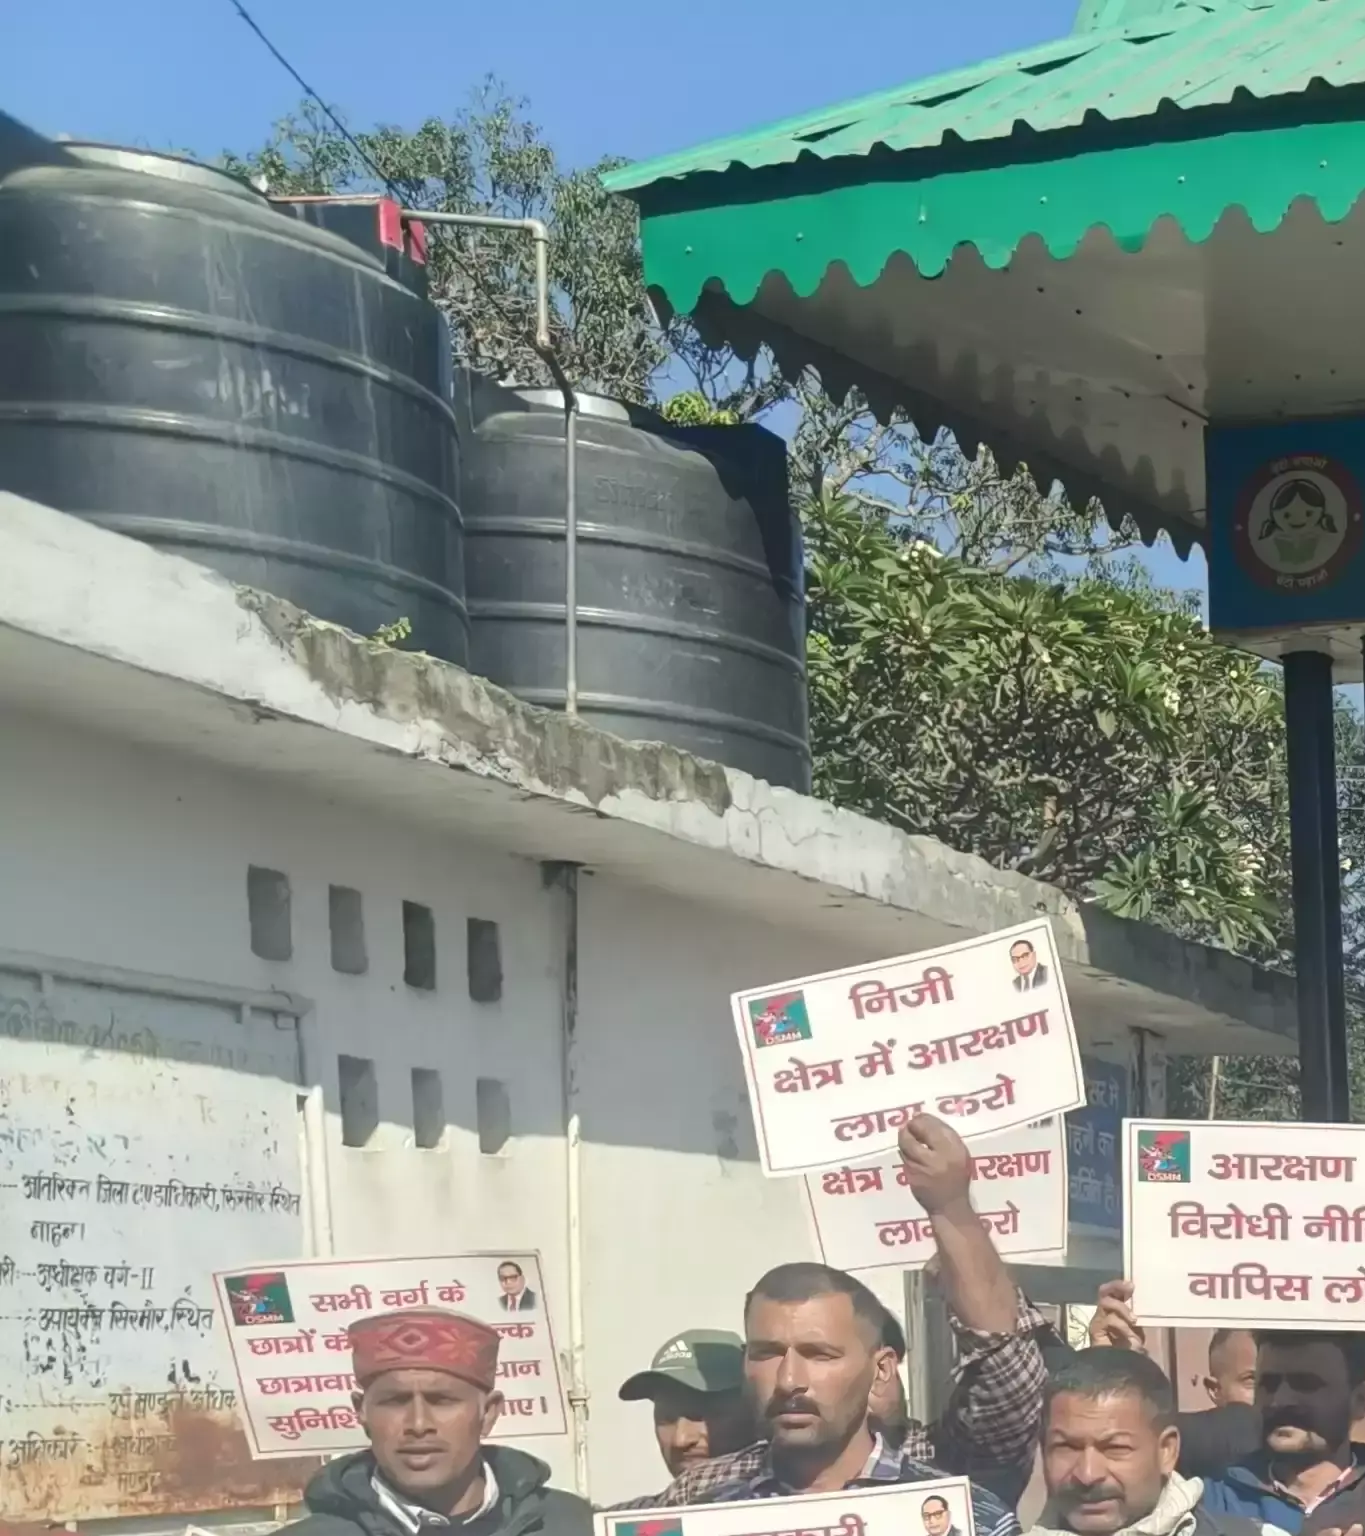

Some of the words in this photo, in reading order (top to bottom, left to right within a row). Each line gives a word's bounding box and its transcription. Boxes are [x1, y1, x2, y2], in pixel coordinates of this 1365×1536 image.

[849, 966, 954, 1020] निजी
[773, 1057, 844, 1093] क्षेत्र
[855, 1038, 897, 1078] में
[908, 1009, 1049, 1069] आरक्षण
[936, 1073, 1016, 1117] करो
[822, 1166, 883, 1195] क्षेत्र
[1208, 1153, 1357, 1182] आरक्षण
[1168, 1201, 1292, 1241] विरोधी
[309, 1285, 372, 1313] सभी
[380, 1280, 430, 1306] वर्ग
[435, 1280, 466, 1304] के
[1188, 1262, 1312, 1300] वापिस
[247, 1329, 317, 1356] छात्रों
